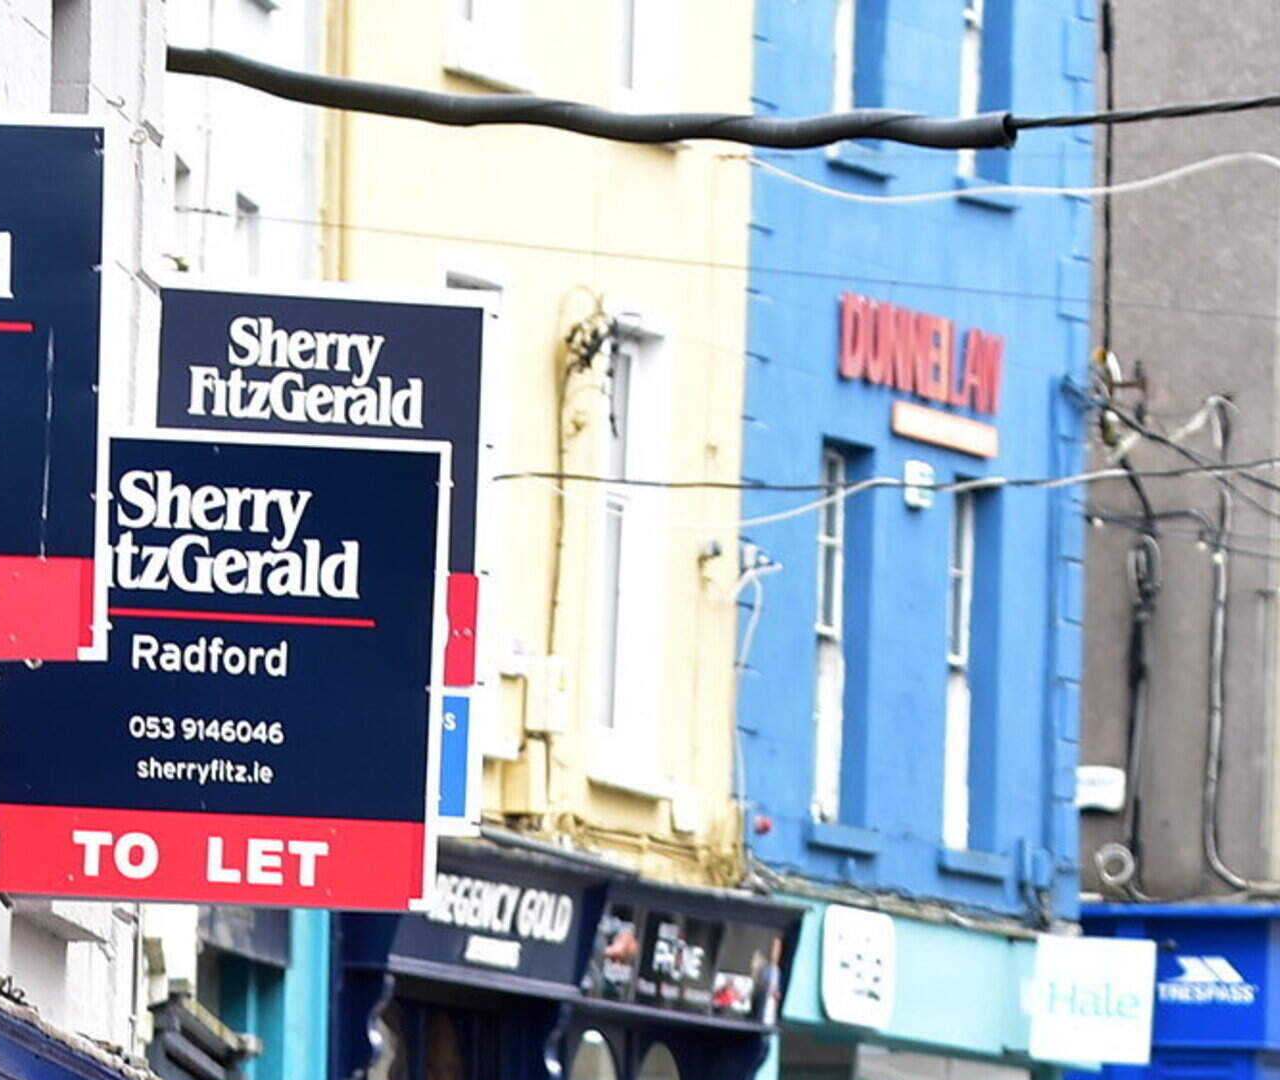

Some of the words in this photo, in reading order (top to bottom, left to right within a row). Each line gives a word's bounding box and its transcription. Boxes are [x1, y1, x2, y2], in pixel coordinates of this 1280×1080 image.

[227, 316, 385, 386] Sherry
[187, 365, 423, 429] FitzGerald
[117, 469, 312, 552] Sherry
[107, 534, 361, 600] tzGerald
[131, 634, 288, 677] Radford
[128, 715, 176, 741] 053
[181, 717, 285, 745] 9146046
[136, 757, 274, 786] sherryfitz.ie
[72, 829, 159, 879] TO
[206, 836, 329, 887] LET
[516, 888, 573, 944] GOLD
[1048, 982, 1142, 1018] Hale
[1158, 982, 1257, 1004] TRESPASS
